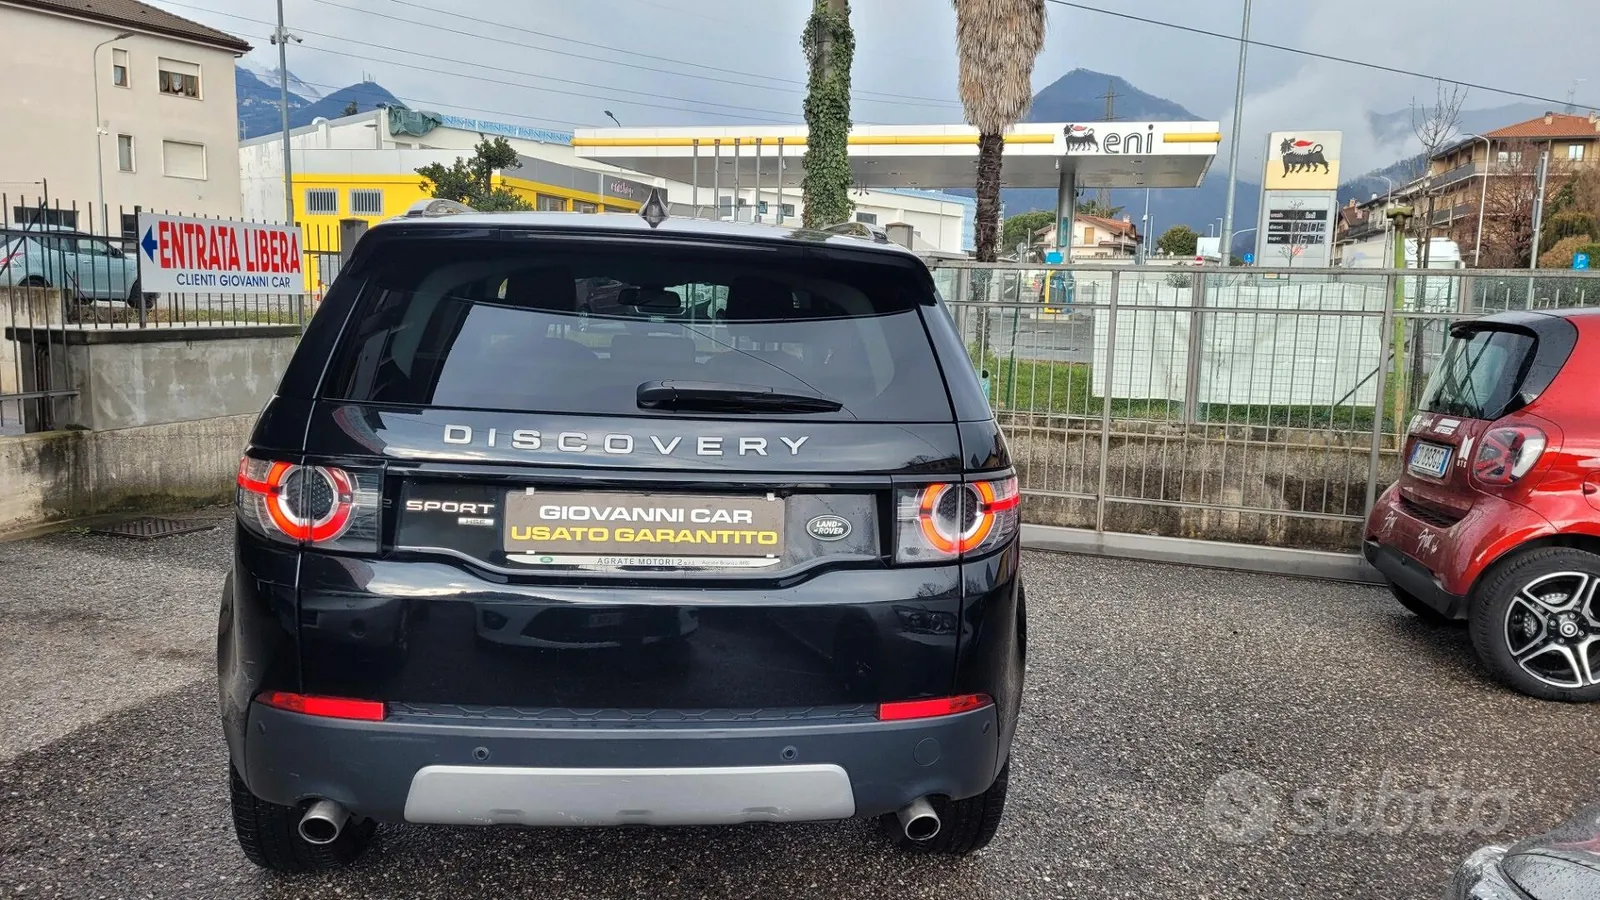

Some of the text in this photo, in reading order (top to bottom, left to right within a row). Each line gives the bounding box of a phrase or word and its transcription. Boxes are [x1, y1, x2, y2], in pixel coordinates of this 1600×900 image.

[1103, 124, 1154, 154] eni
[158, 220, 301, 273] ENTRATA LIBERA
[1578, 254, 1586, 265] P
[176, 273, 291, 288] CLIENTI GIOVANNI CAR
[443, 424, 809, 456] DISCOVERY
[1456, 460, 1467, 468] BTS
[406, 500, 495, 514] SPORT
[539, 505, 753, 524] GIOVANNI CAR
[816, 520, 838, 528] LAND
[818, 527, 844, 535] ROVER
[511, 527, 778, 545] USATO GARANTITO
[597, 557, 635, 565] AGRATE
[638, 558, 674, 566] MOTORI
[677, 558, 683, 566] 2
